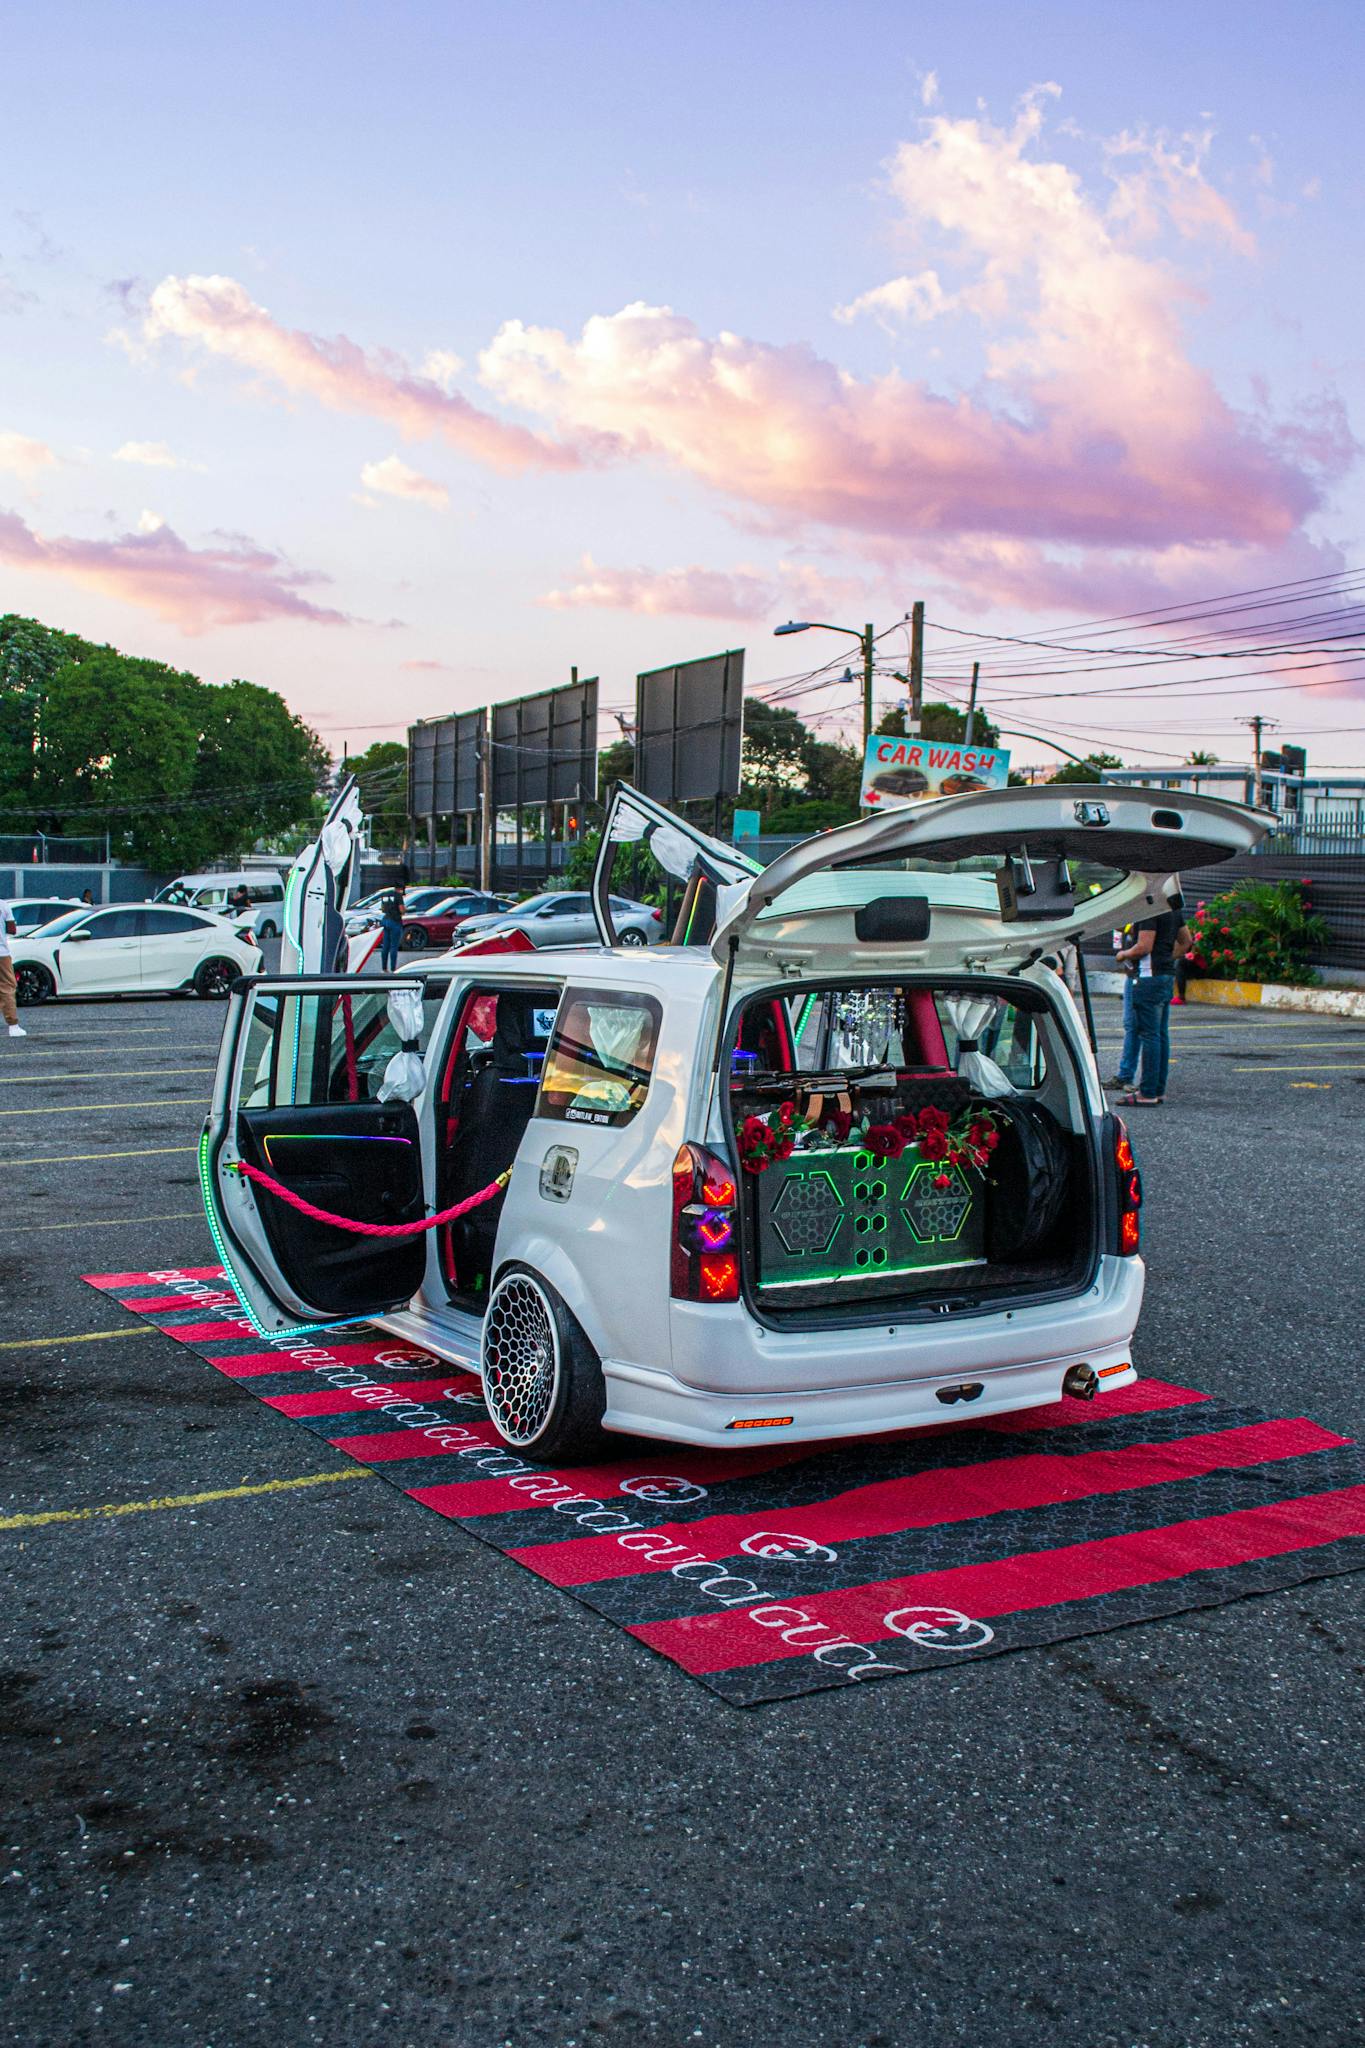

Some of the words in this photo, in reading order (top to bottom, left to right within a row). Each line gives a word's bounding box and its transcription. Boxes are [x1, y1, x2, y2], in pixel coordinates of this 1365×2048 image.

[877, 743, 923, 766] CAR
[928, 748, 996, 772] WASH
[290, 1349, 378, 1388] GUCCI
[351, 1387, 450, 1428] GUCCI
[424, 1427, 535, 1477] GUCCI
[509, 1476, 644, 1533] GUCCI
[617, 1533, 775, 1607] GUCCI
